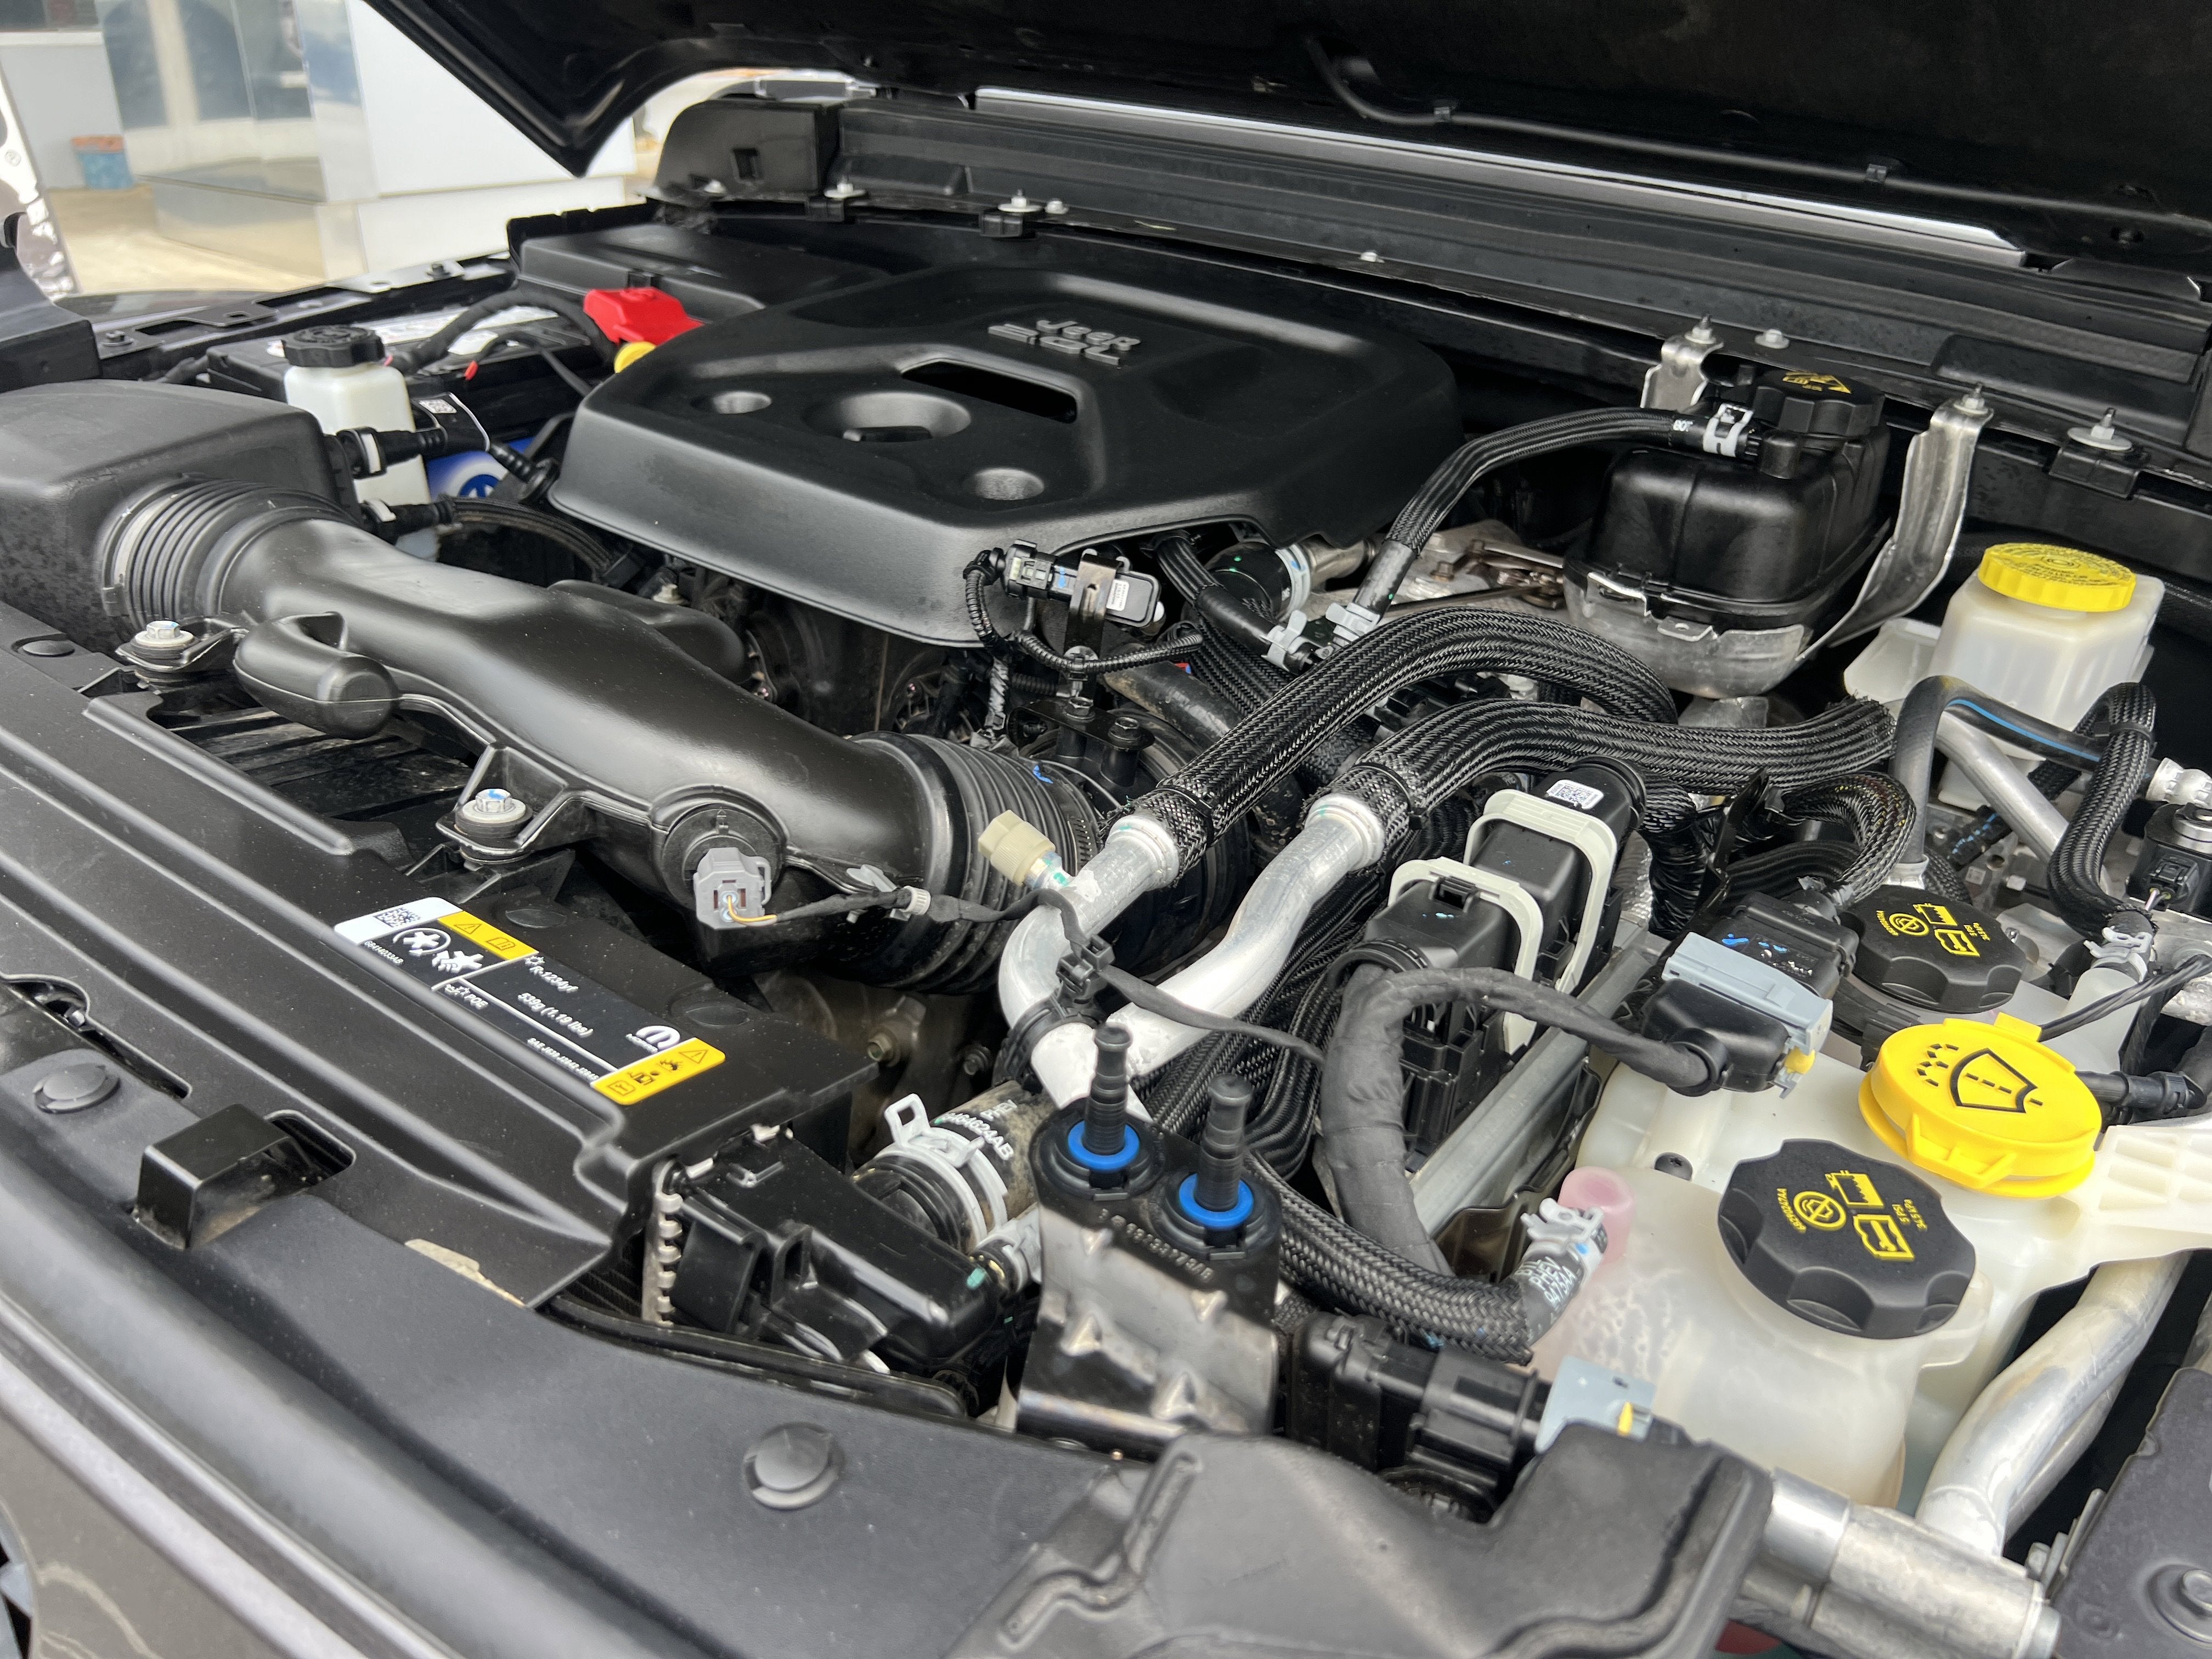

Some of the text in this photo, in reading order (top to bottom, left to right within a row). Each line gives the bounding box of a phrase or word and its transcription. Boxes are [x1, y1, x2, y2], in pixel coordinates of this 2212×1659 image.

[529, 966, 579, 993] R-1234yf
[464, 993, 489, 1010] POE
[517, 992, 545, 1012] 539g
[567, 1020, 594, 1038] lbs)
[527, 1037, 546, 1053] SAE
[1776, 1187, 1807, 1233] 68290247AA
[1892, 1204, 1908, 1217] PSI
[1903, 1199, 1921, 1214] kPa
[1528, 1256, 1562, 1291] PHEV
